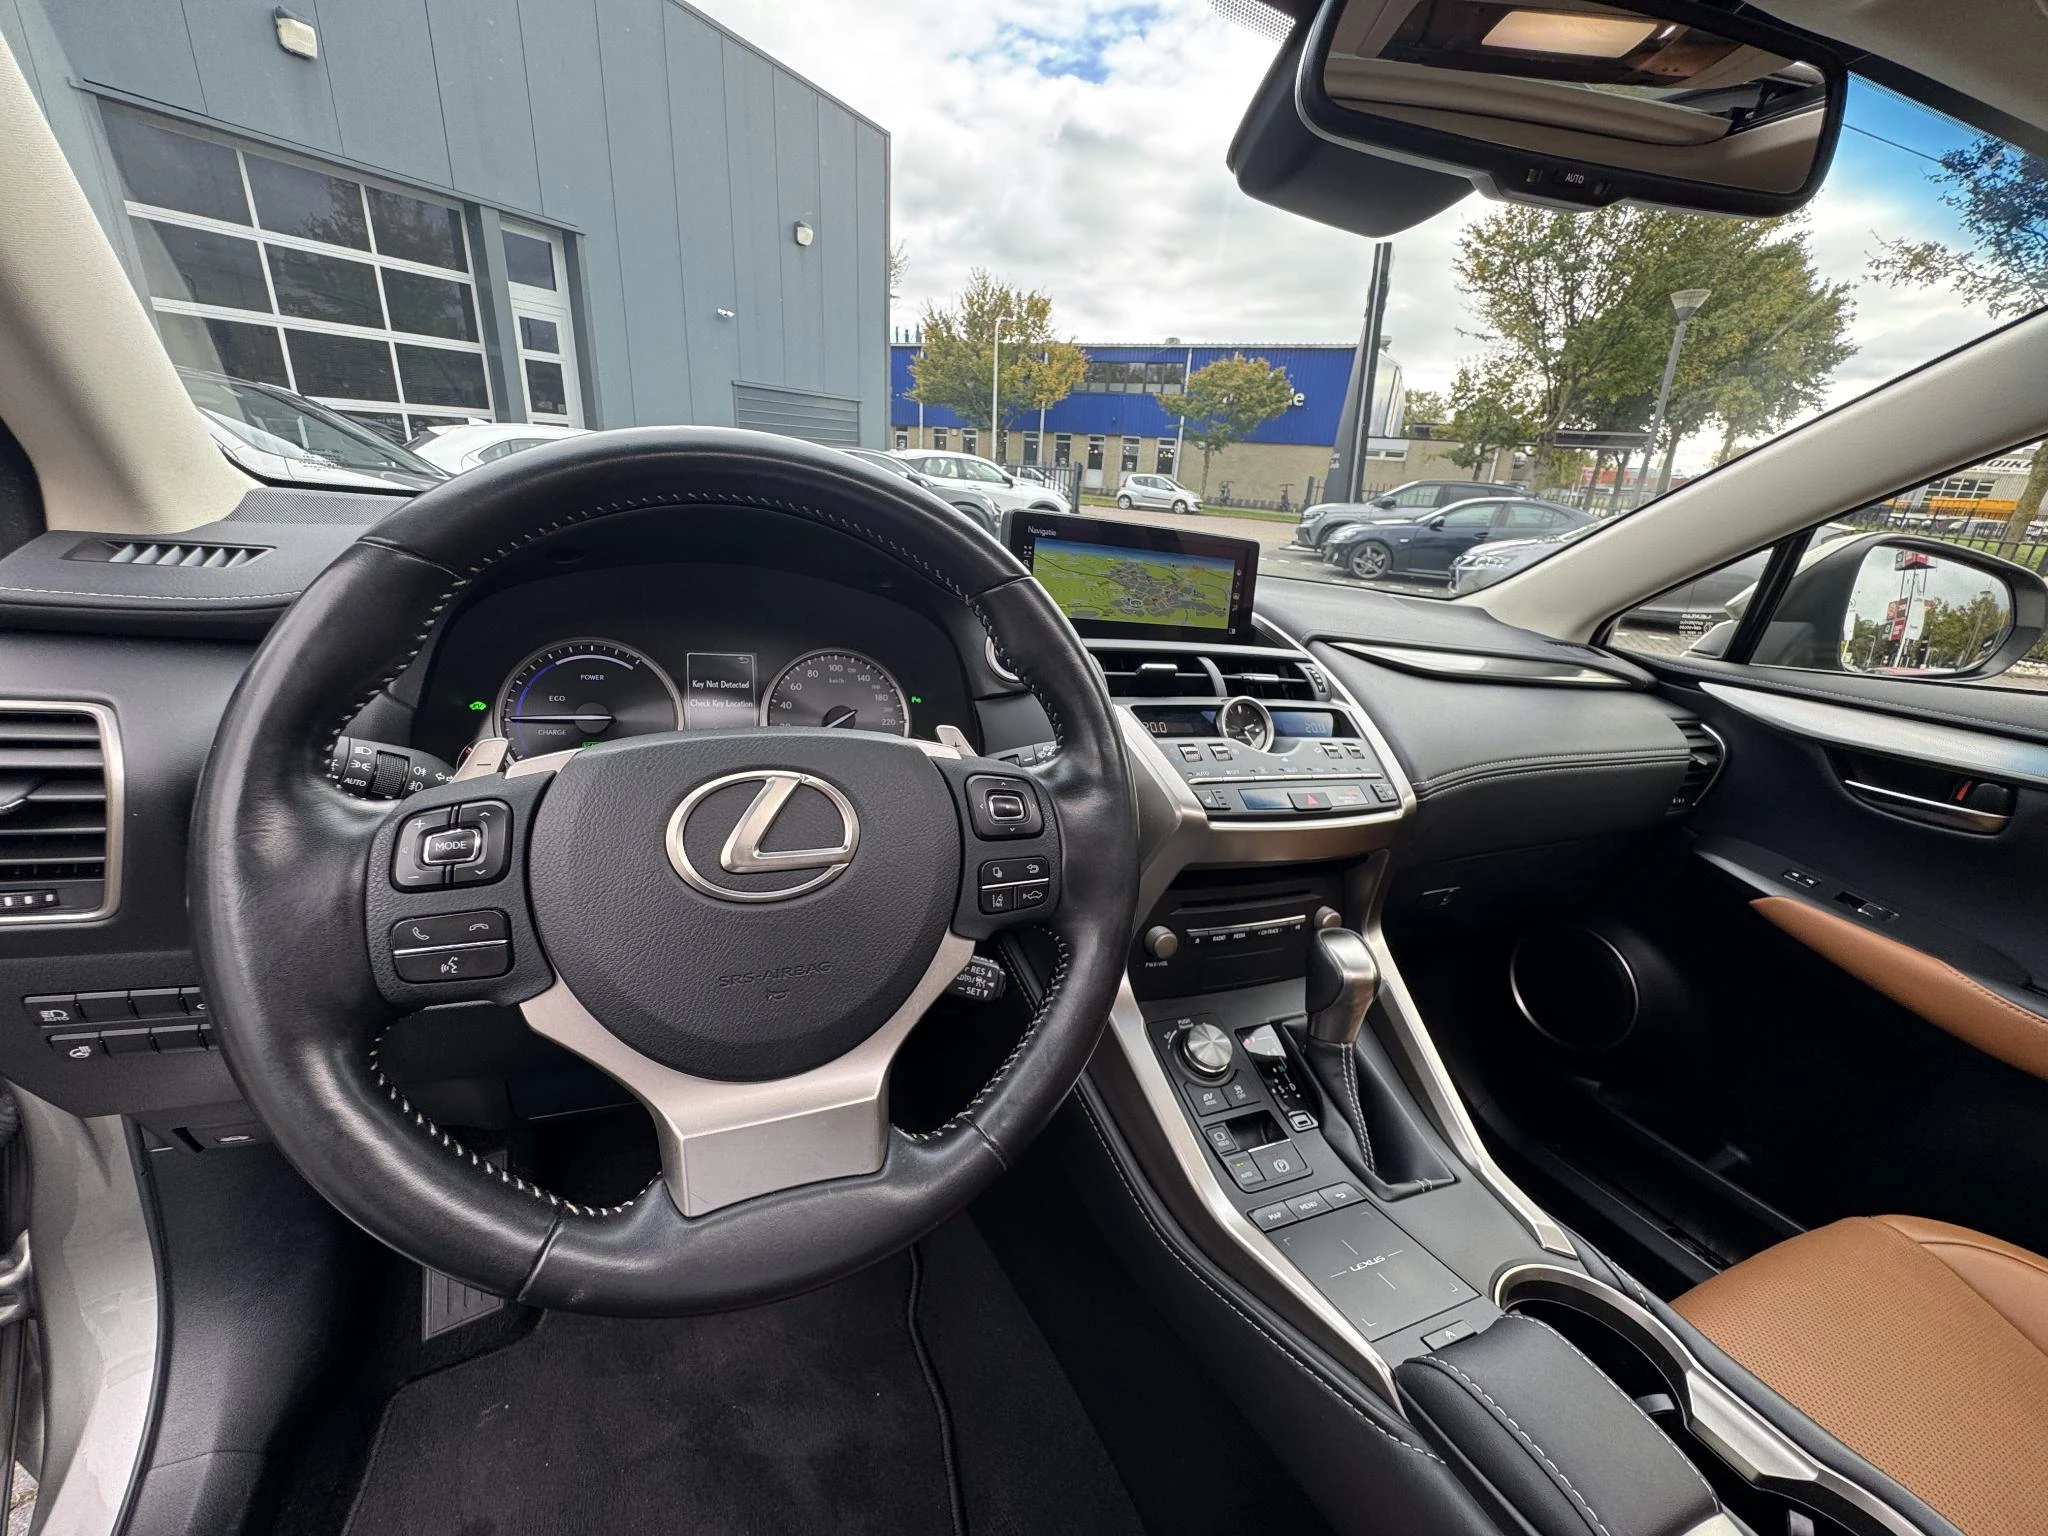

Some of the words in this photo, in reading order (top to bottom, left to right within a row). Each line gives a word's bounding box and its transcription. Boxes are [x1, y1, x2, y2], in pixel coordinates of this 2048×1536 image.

[1565, 172, 1585, 184] AUTO
[829, 664, 843, 672] 100
[807, 670, 819, 678] 80
[857, 674, 871, 682] 140
[692, 680, 704, 690] Key
[706, 680, 719, 688] Not
[720, 680, 750, 689] Detected
[790, 683, 803, 691] 60
[690, 699, 710, 708] Check
[712, 699, 724, 709] Key
[725, 700, 753, 708] Location
[780, 701, 793, 710] 40
[881, 718, 896, 726] 220
[343, 777, 367, 787] AUTO
[435, 840, 467, 851] MODE
[970, 965, 986, 976] RES
[966, 986, 982, 997] SET
[1299, 1201, 1318, 1211] MENU
[1267, 1212, 1282, 1221] MAP
[1349, 1255, 1386, 1272] LEXUS
